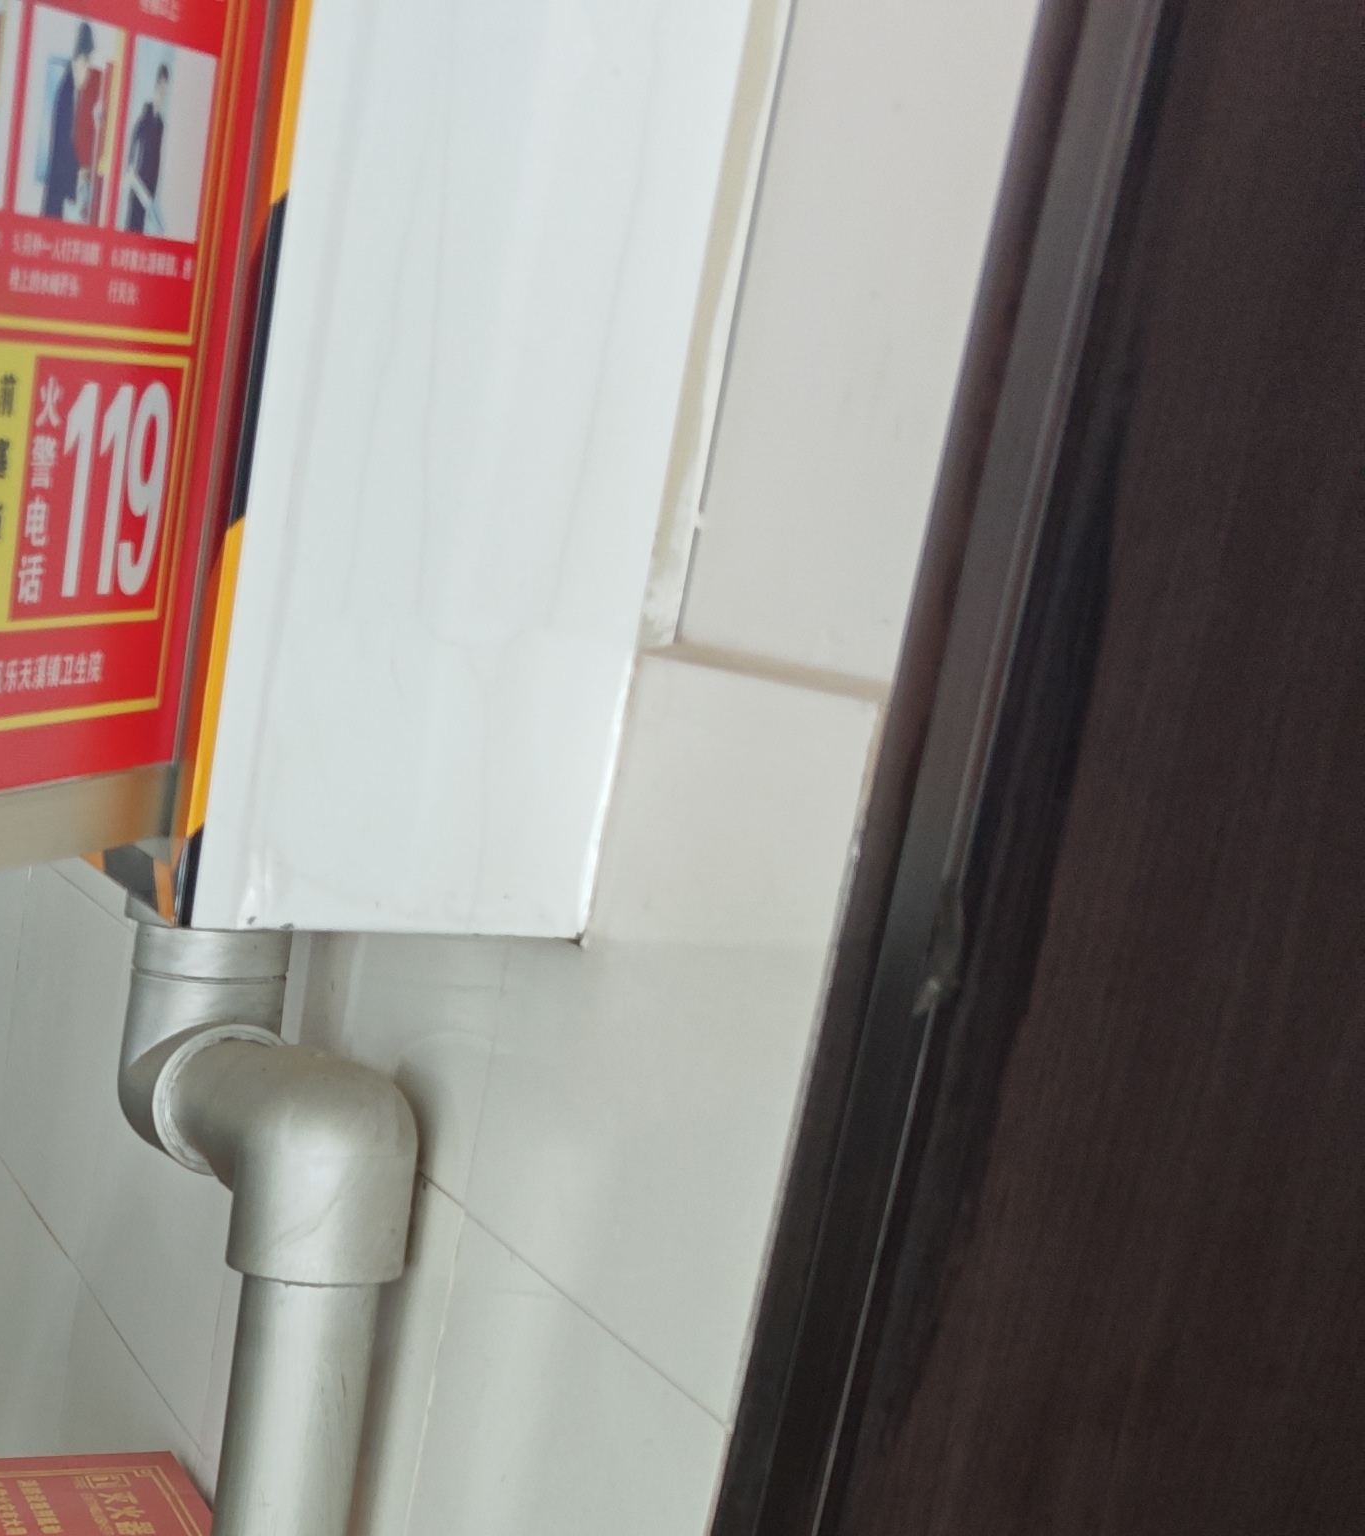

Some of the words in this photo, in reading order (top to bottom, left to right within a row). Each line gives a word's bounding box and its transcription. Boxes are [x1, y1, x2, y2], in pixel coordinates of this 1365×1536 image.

[18, 376, 63, 605] 火警电话
[63, 380, 171, 597] 119
[97, 1490, 157, 1535] 灭火器
